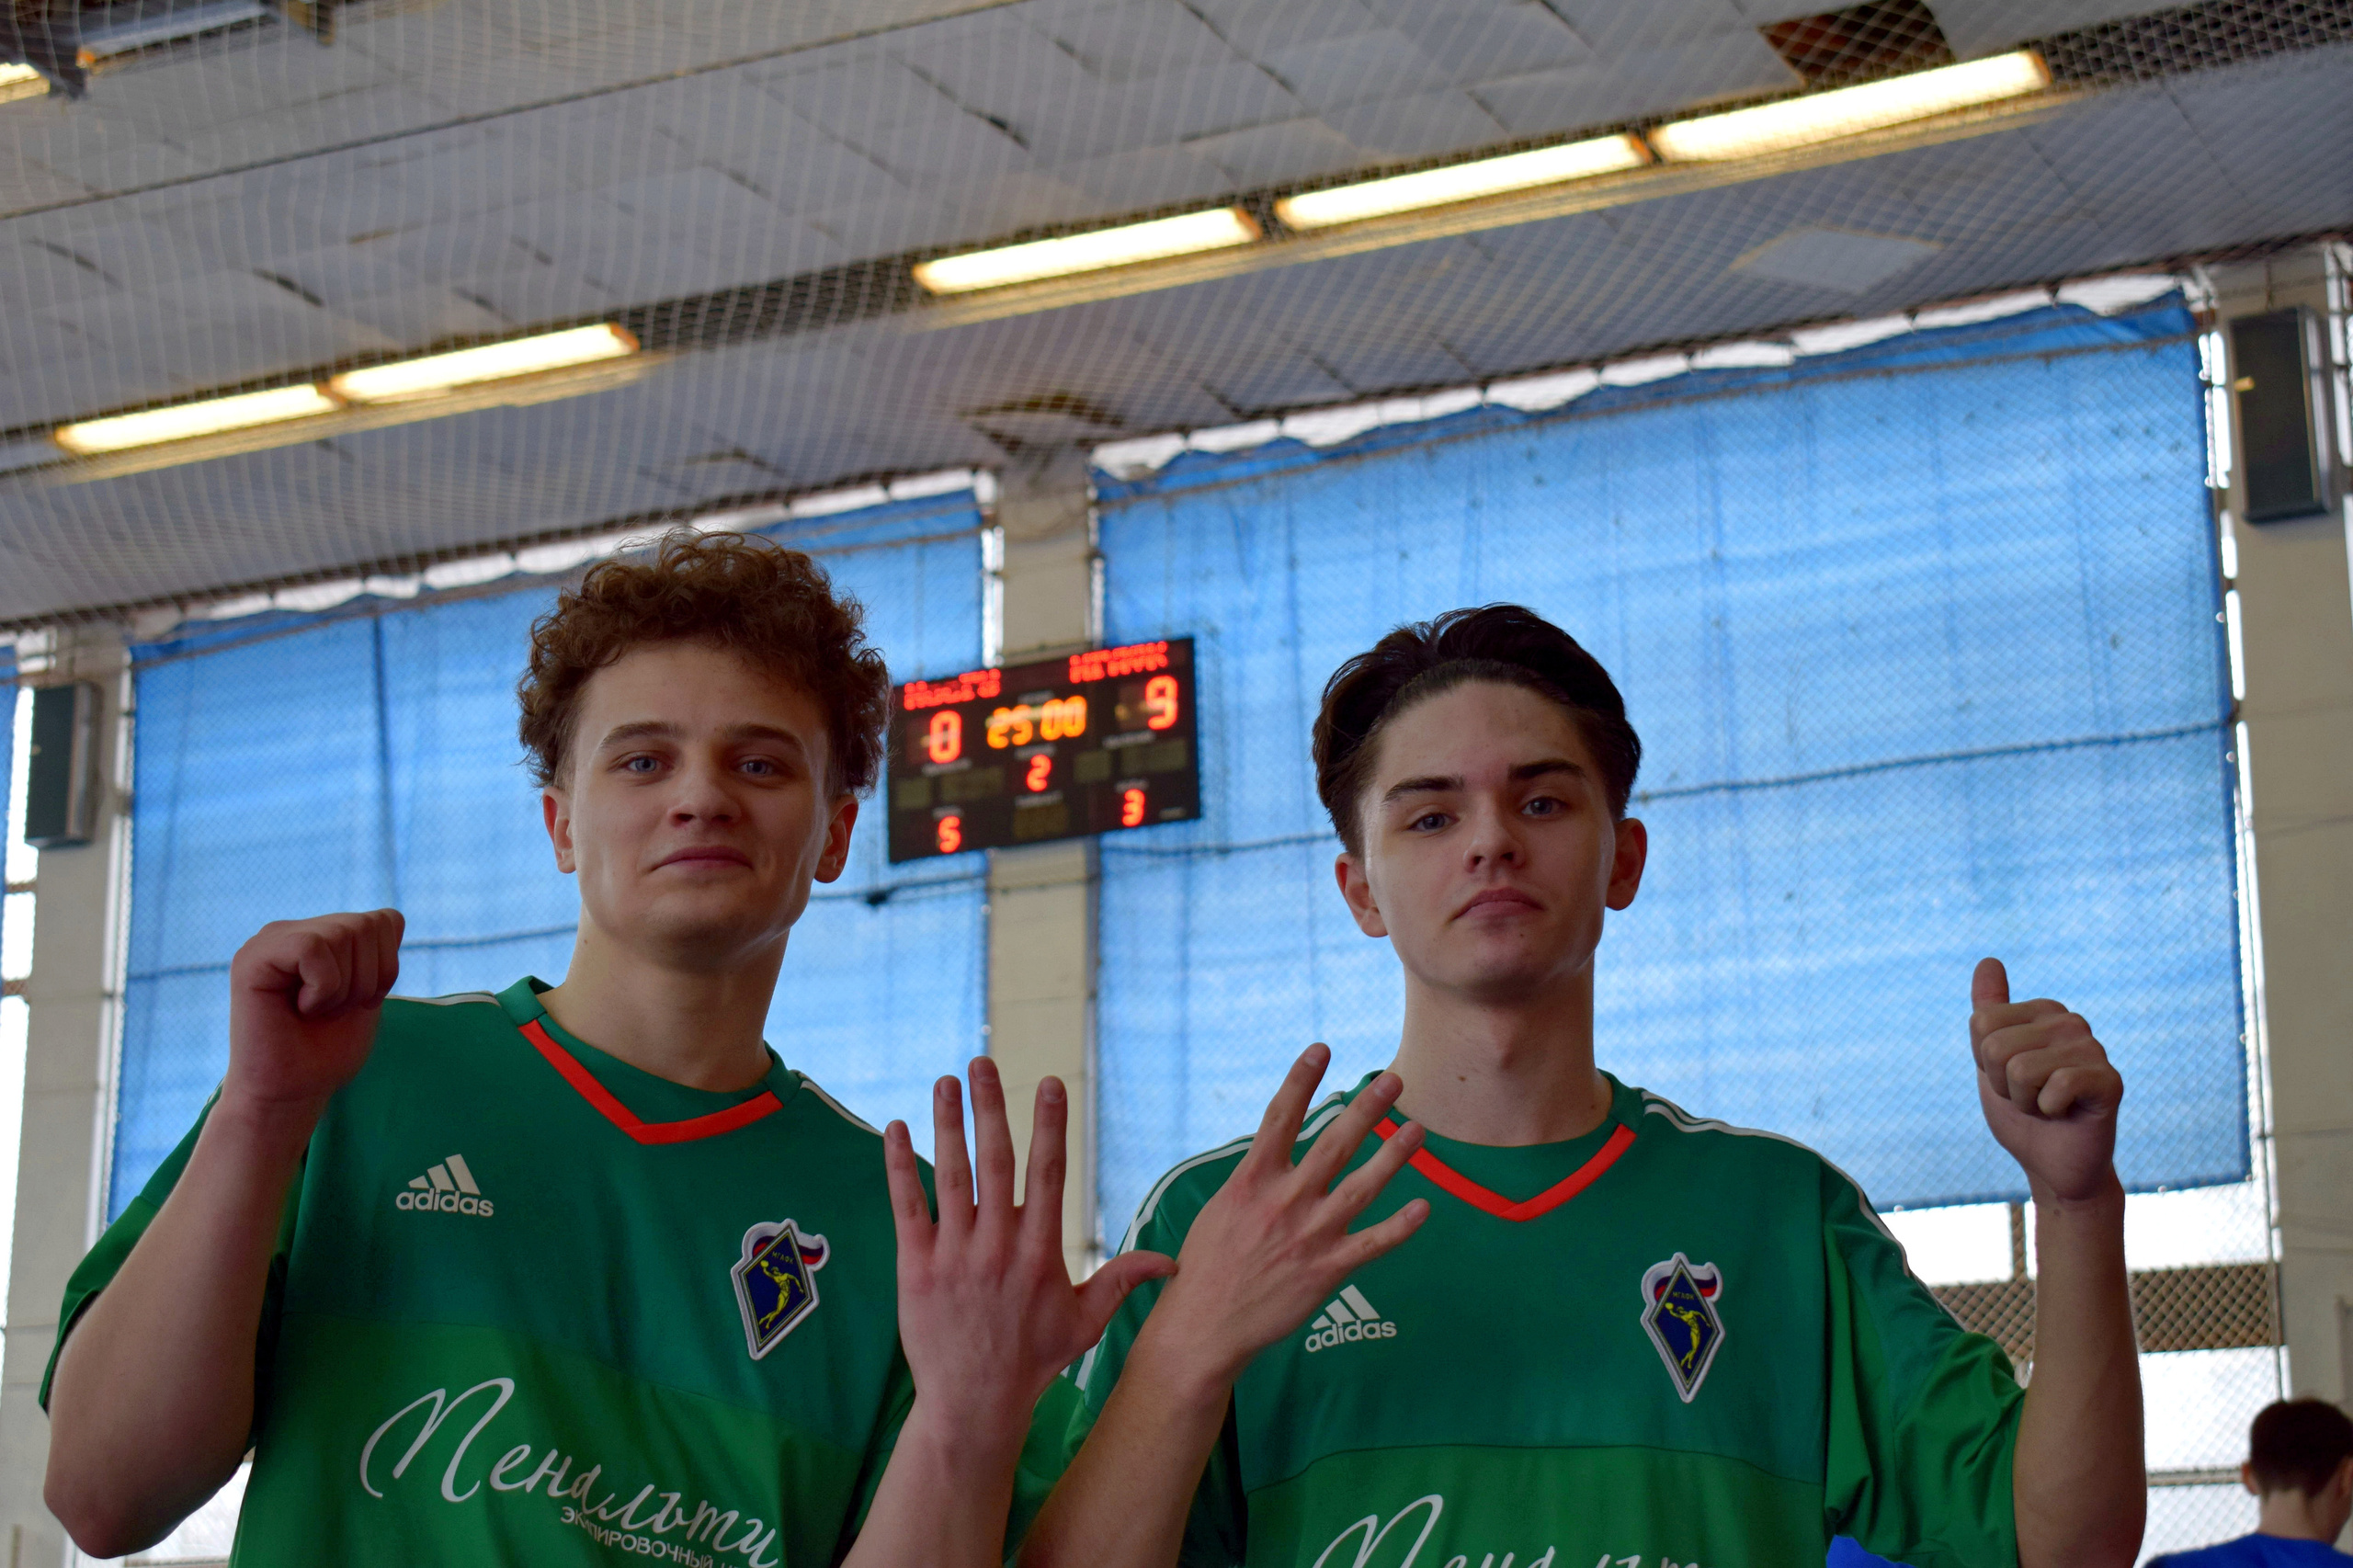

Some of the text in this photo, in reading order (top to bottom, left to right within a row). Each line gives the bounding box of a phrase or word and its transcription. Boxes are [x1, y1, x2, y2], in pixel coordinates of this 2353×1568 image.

[1145, 675, 1178, 730] 9
[929, 710, 961, 764] 0
[1027, 754, 1051, 791] 2
[1122, 789, 1145, 827] 3
[395, 1188, 494, 1218] adidas
[1304, 1318, 1398, 1353] adidas
